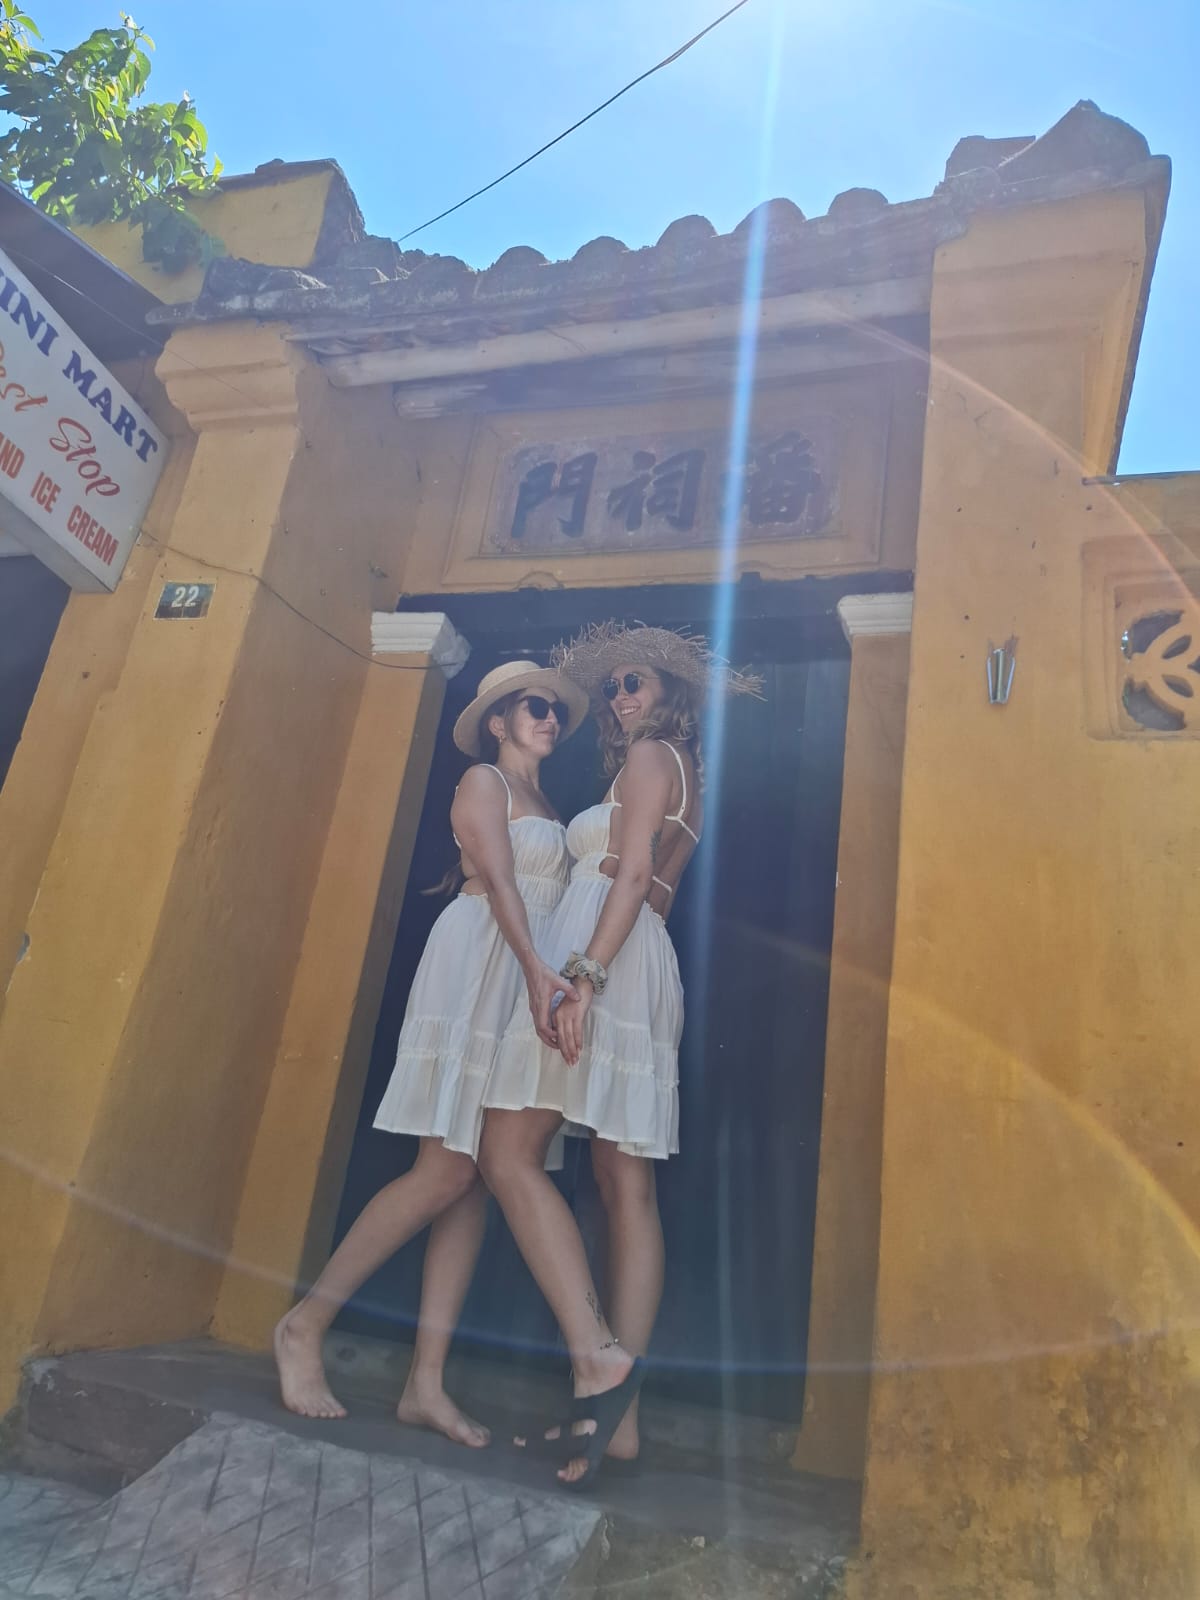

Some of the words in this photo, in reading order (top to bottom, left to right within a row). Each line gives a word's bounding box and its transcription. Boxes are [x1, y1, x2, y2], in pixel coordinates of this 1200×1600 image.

[0, 264, 60, 357] INI
[62, 350, 158, 463] MART
[0, 432, 25, 479] ND
[30, 472, 62, 513] ICE
[67, 505, 119, 566] CREAM
[49, 417, 120, 496] Stop
[171, 585, 200, 608] 22
